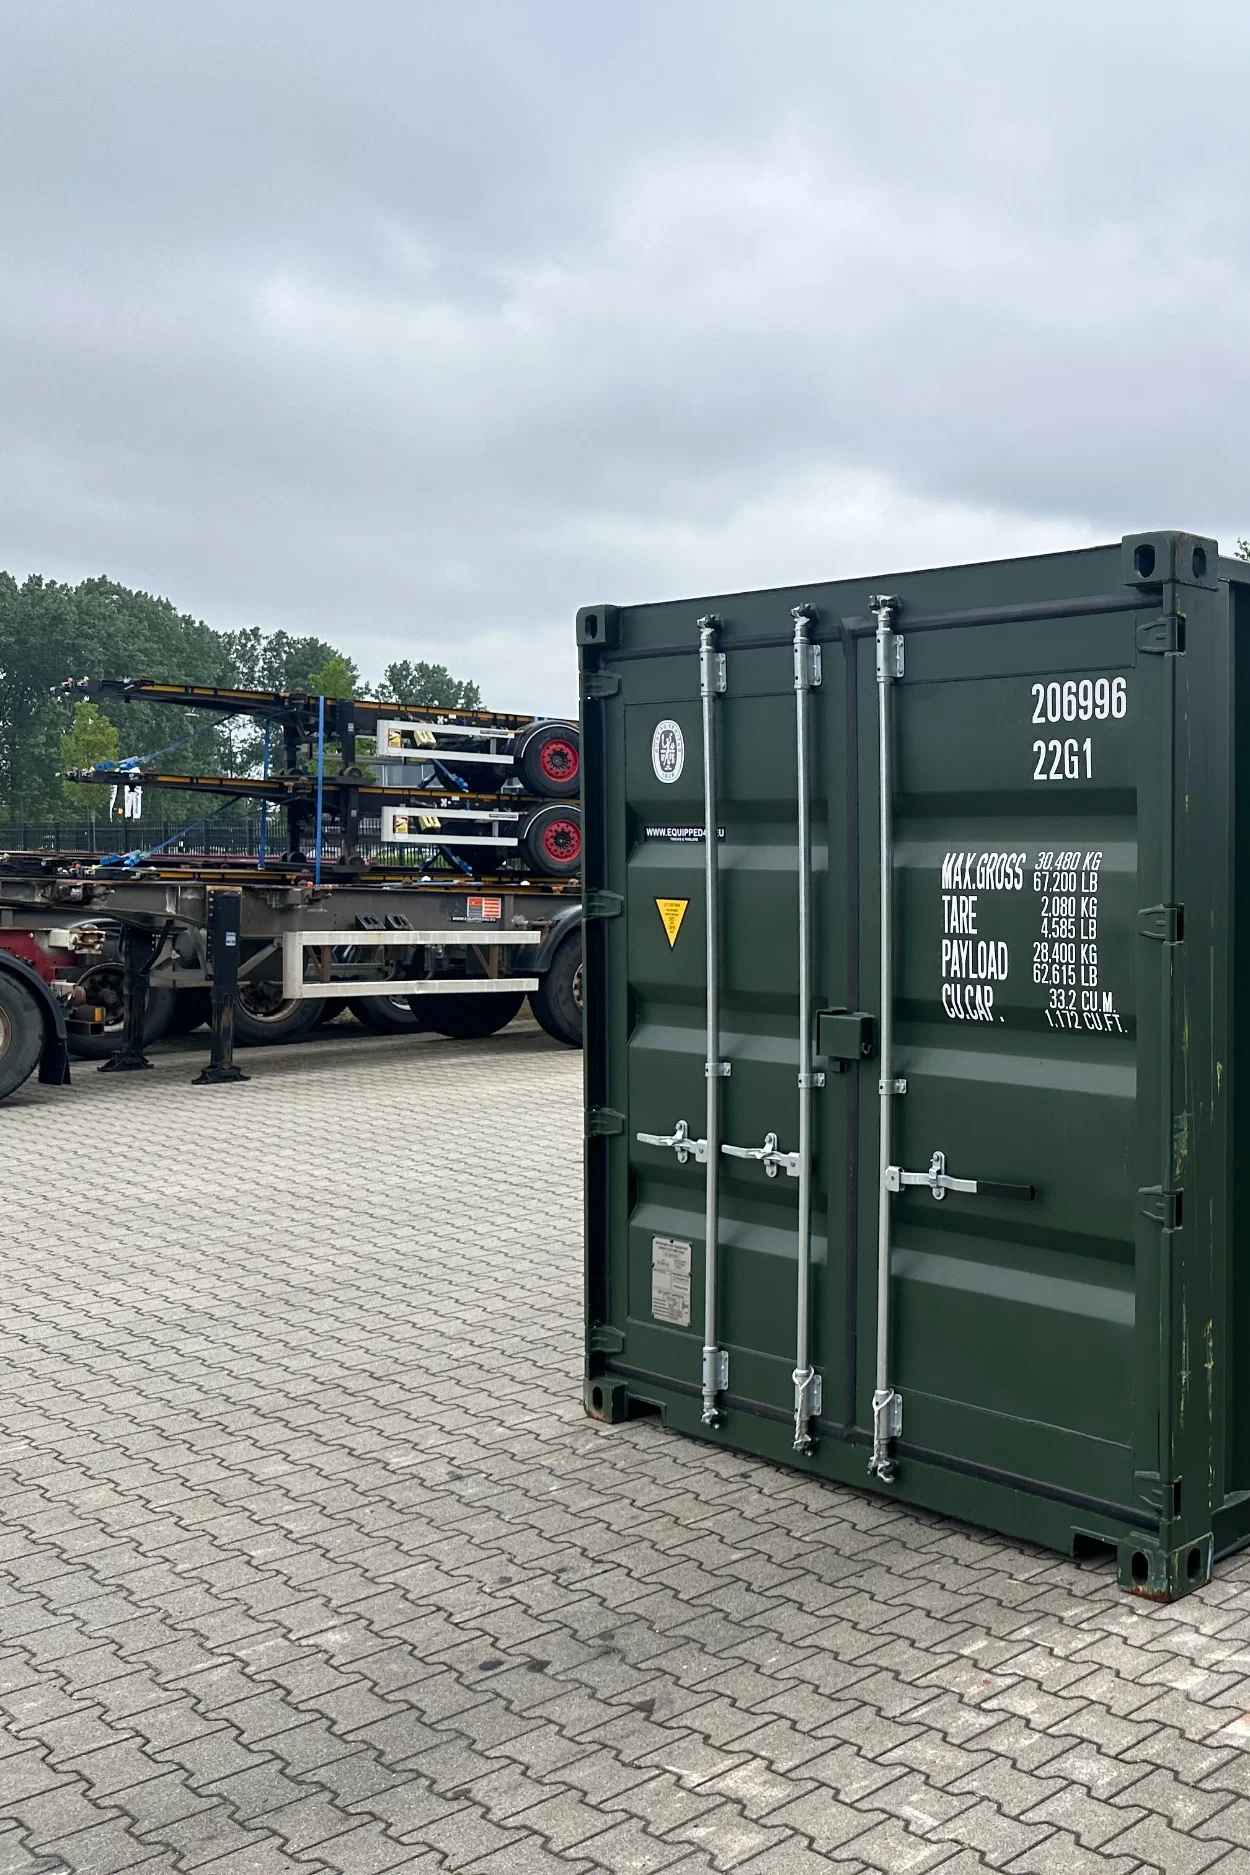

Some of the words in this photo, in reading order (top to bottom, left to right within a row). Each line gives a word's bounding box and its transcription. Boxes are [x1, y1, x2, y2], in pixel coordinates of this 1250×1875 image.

[1031, 677, 1127, 724] 206996
[1032, 737, 1092, 780] 22G1
[646, 827, 725, 838] WWW.EQUIPPED4EU
[941, 852, 1026, 890] MAX.GROSS
[1082, 851, 1103, 871] KG
[1033, 871, 1077, 892] 67,200
[1081, 871, 1098, 893] LB
[941, 895, 978, 934] TARE
[1080, 896, 1098, 918] KG
[1041, 917, 1076, 939] 4,585
[1080, 918, 1097, 940] LB
[941, 939, 1008, 980] PAYLOAD
[1080, 943, 1098, 965] KG
[1033, 963, 1076, 986] 62,615
[1080, 965, 1098, 987] LB
[1049, 988, 1077, 1010] 33.2
